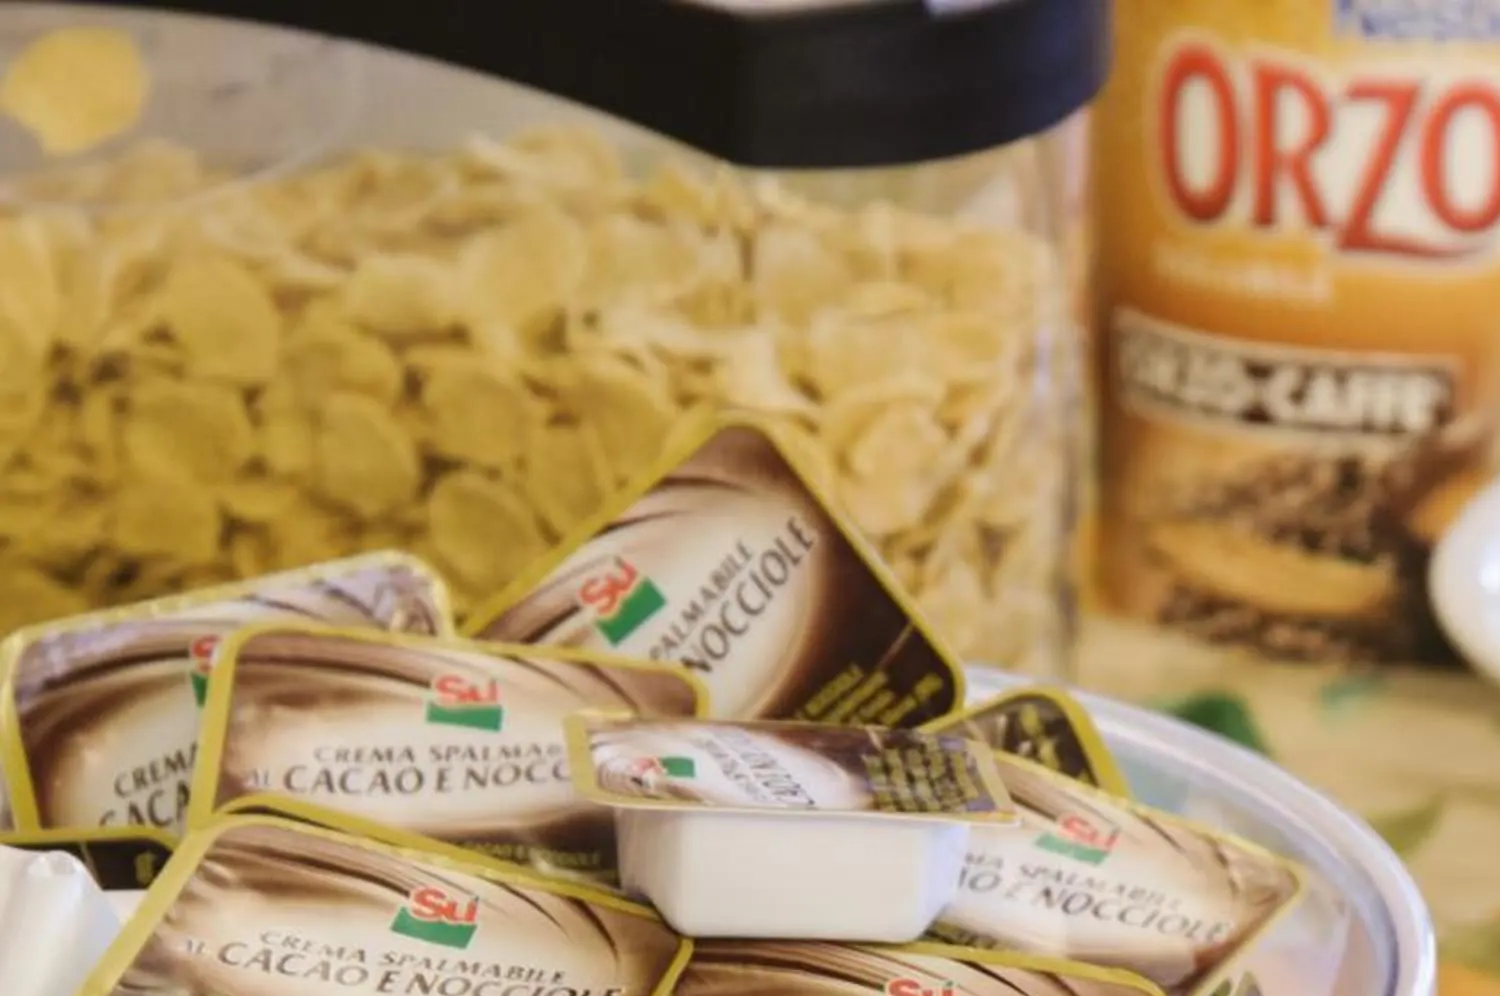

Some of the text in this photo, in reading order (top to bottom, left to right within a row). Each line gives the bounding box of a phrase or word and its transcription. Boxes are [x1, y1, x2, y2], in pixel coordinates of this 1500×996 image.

[650, 540, 752, 661] PALMABILE
[680, 516, 814, 673] NOCCIOLE
[283, 764, 425, 795] CACAO
[435, 768, 451, 792] E
[463, 762, 573, 791] NOCC
[314, 743, 563, 764] CREMA SPALMAB
[99, 780, 190, 828] ACA
[1033, 886, 1232, 943] NOCCIOLE
[218, 940, 370, 987] CACAO
[377, 970, 400, 994] E
[259, 930, 568, 985] CREMA SPALMABILE
